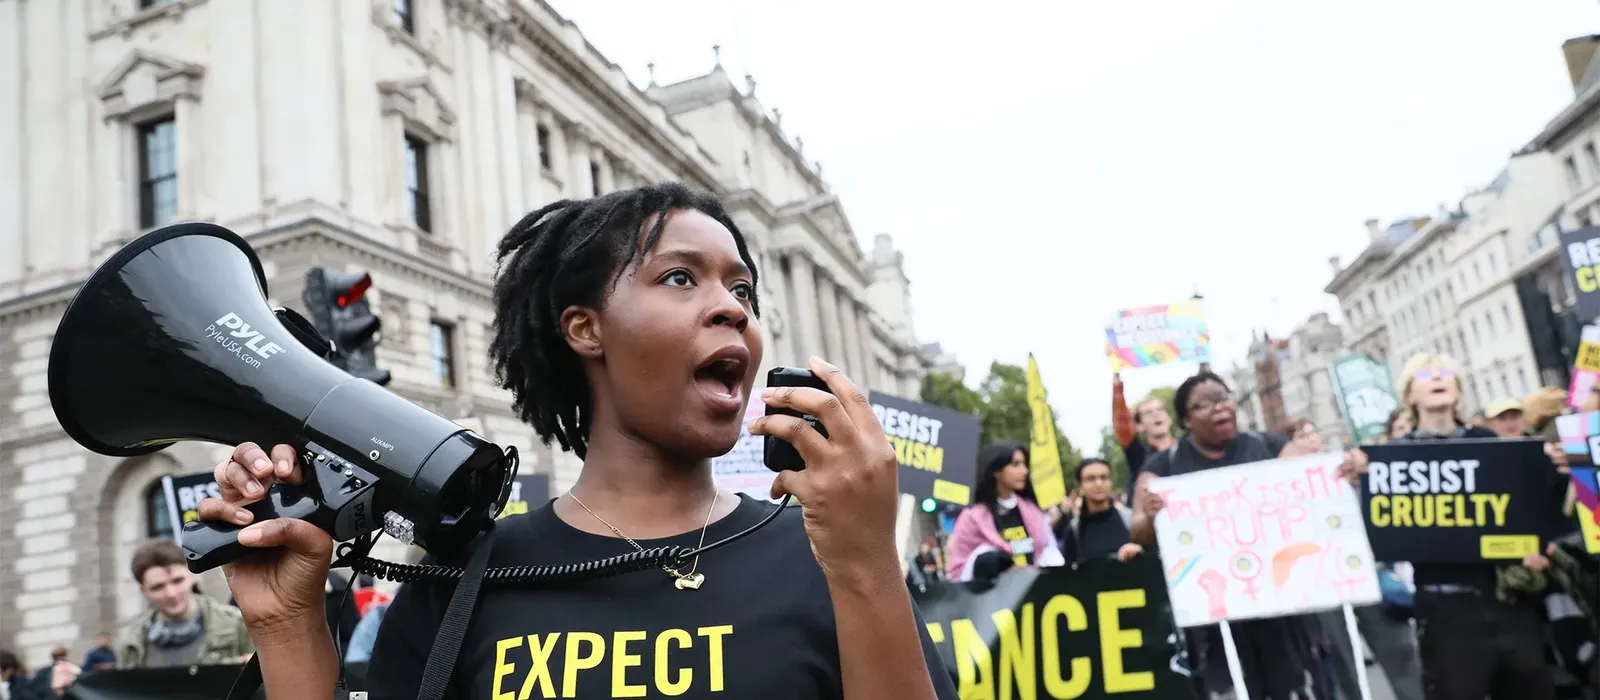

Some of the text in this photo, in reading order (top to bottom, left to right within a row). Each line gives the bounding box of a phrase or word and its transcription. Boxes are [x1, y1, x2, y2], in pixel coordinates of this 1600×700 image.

[205, 324, 261, 369] PyleUSA.com
[215, 312, 284, 359] PYLE
[886, 434, 944, 474] XISM
[1368, 460, 1480, 494] RESIST
[1370, 493, 1510, 527] CRUELTY
[491, 625, 733, 700] EXPECT
